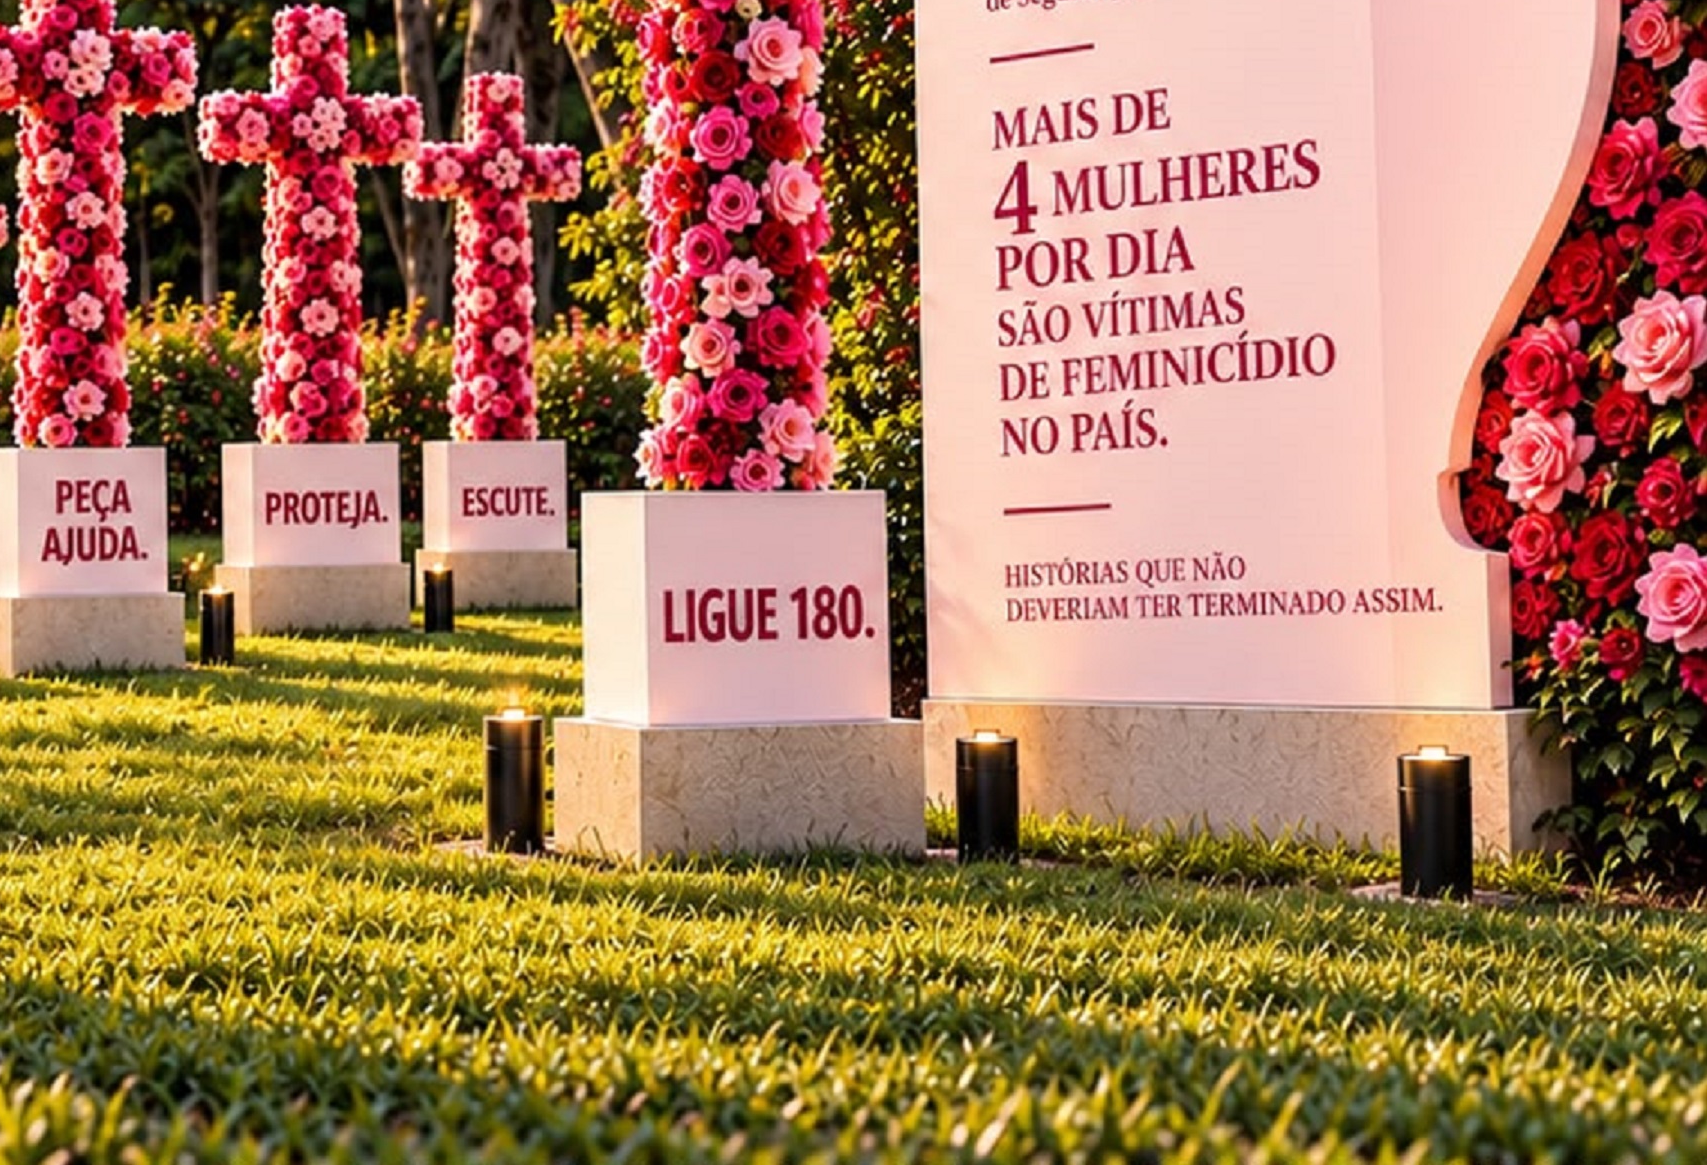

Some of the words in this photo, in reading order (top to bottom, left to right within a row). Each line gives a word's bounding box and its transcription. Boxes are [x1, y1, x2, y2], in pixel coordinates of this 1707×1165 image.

[994, 98, 1099, 150] MAIS
[1112, 87, 1171, 136] DE
[994, 160, 1038, 235] 4
[1052, 139, 1321, 217] MULHERES
[996, 237, 1094, 291] POR
[1106, 226, 1195, 279] DIA
[998, 300, 1072, 347] SÃO
[1081, 286, 1248, 340] VÍTIMAS
[1000, 361, 1050, 401] DE
[1061, 329, 1336, 397] FEMINICÍDIO
[1002, 416, 1060, 457] NO
[1070, 398, 1168, 453] PAÍS.
[56, 479, 132, 523] PEÇA
[265, 490, 388, 529] PROTEJA.
[462, 486, 555, 517] ESCUTE.
[41, 525, 148, 566] AJUDA.
[1005, 557, 1129, 588] HISTÓRIAS
[1135, 557, 1186, 589] QUE
[1192, 551, 1246, 582] NÃO
[664, 587, 779, 643] LIGUE
[790, 584, 875, 640] 180.
[1007, 595, 1129, 622] DEVERIAM
[1135, 593, 1182, 618] TER
[1187, 589, 1346, 617] TERMINADO
[1352, 587, 1443, 614] ASSIM.
